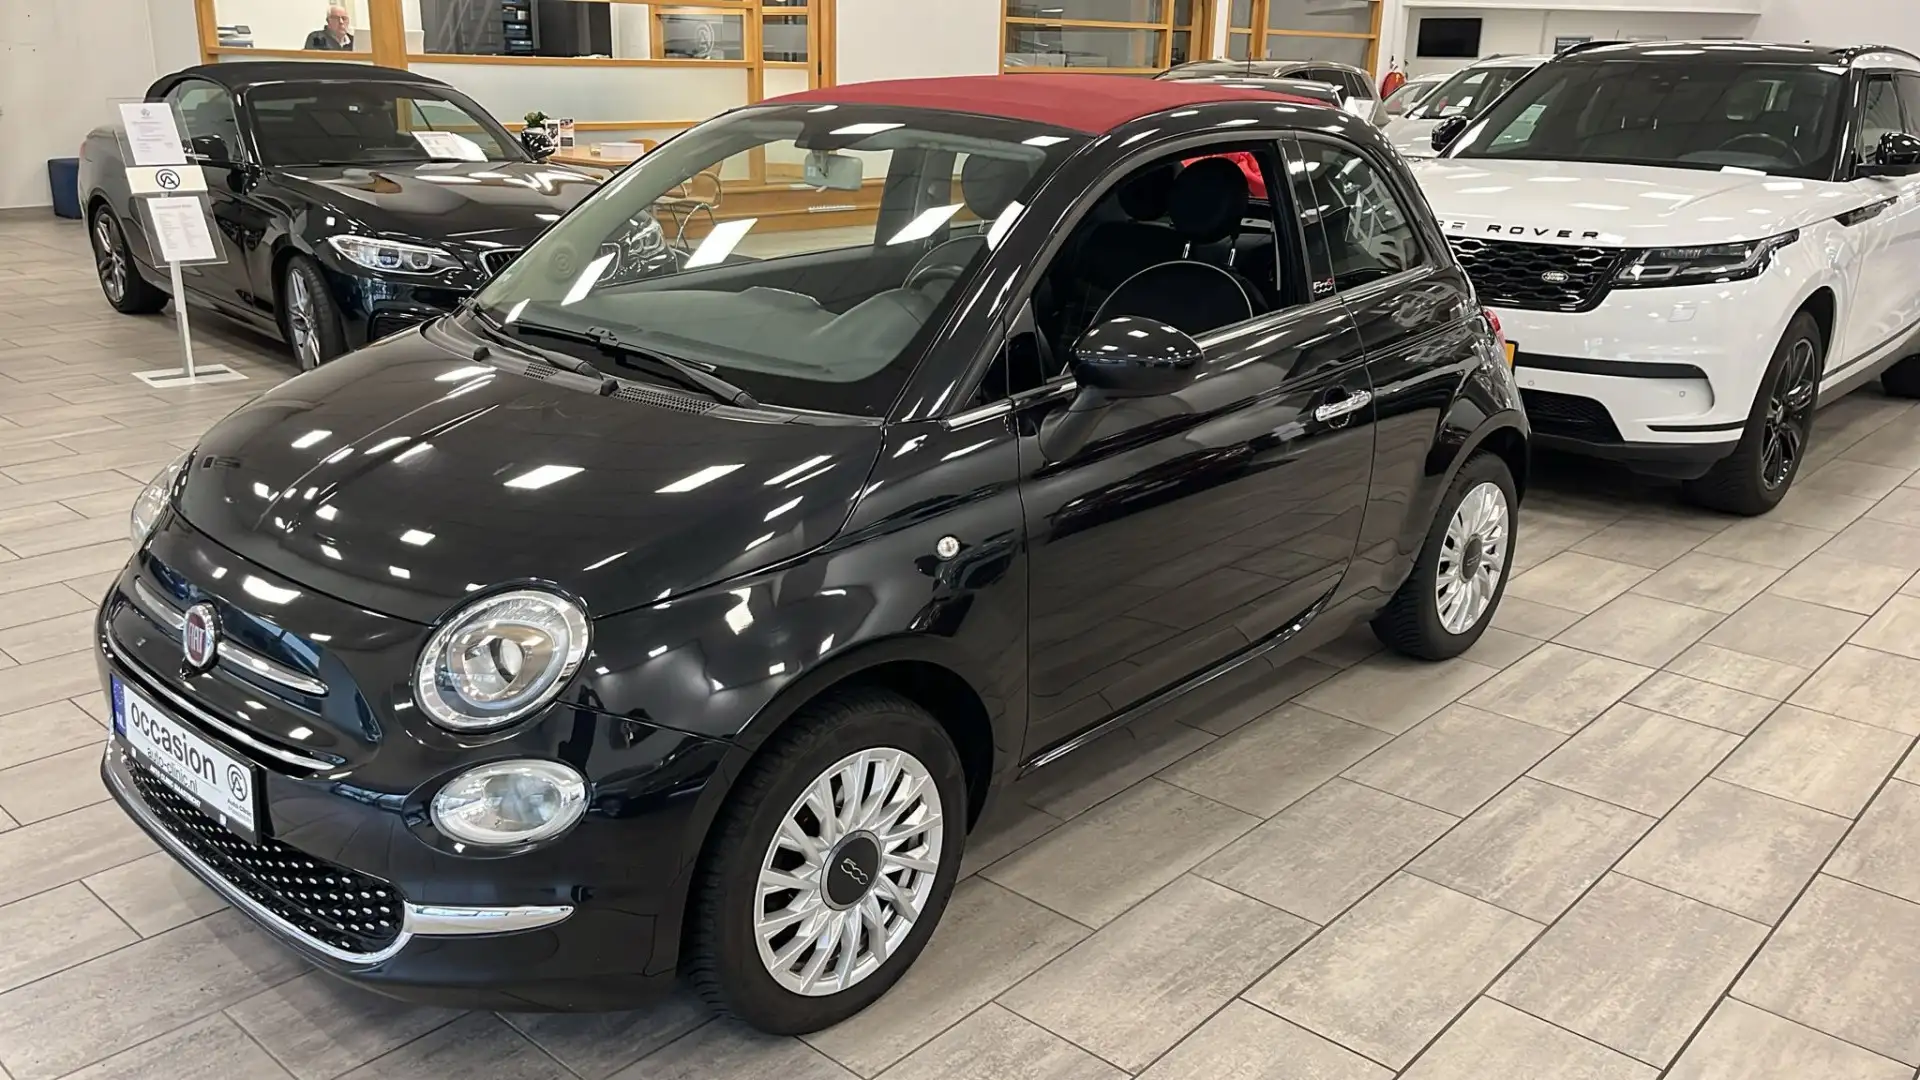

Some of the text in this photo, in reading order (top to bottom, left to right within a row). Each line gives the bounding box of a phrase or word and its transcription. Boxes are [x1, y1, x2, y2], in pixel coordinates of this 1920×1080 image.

[1487, 224, 1598, 239] ROVER
[188, 622, 206, 654] FIAT
[131, 702, 216, 784] occasion
[841, 858, 869, 885] 500
